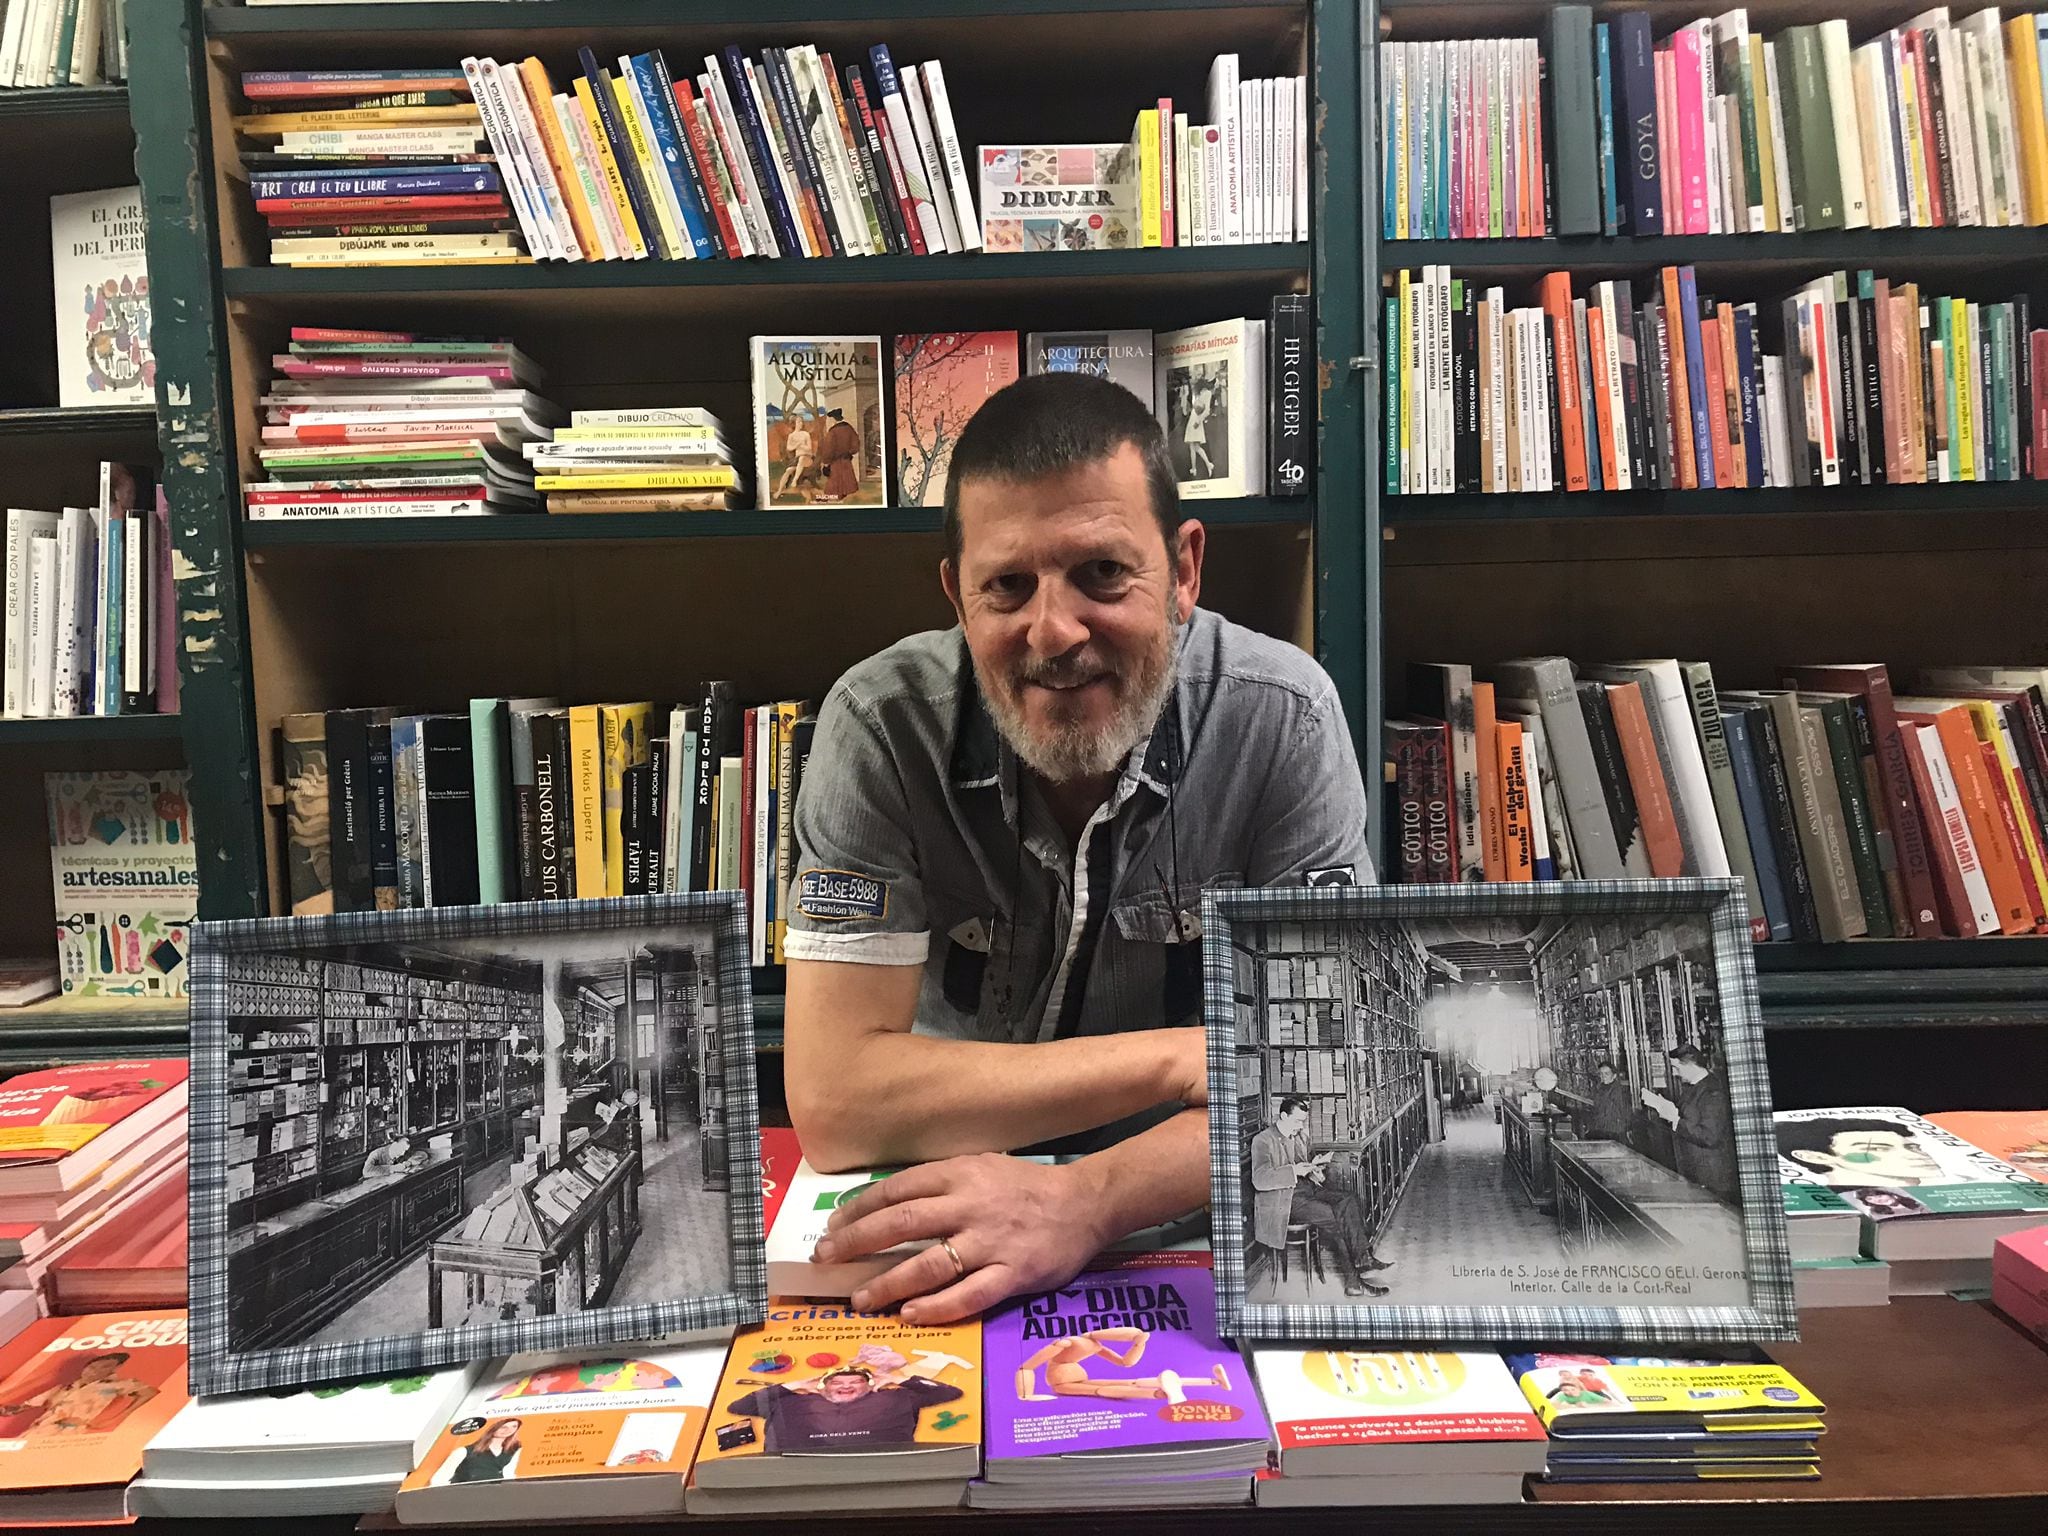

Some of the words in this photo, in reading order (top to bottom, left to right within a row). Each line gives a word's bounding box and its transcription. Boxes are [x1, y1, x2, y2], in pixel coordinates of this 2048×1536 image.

[1705, 45, 1713, 98] CROMÁTICA
[591, 82, 607, 112] BOTÁNICA
[356, 132, 382, 140] MANGA
[385, 132, 414, 140] MASTER
[416, 130, 442, 139] CLASS
[602, 111, 618, 144] ACUARELA
[1936, 110, 1948, 160] LEONARDO
[309, 134, 342, 144] CHIBI
[866, 128, 881, 152] TINTA
[946, 135, 958, 158] VEGETAL
[1227, 116, 1236, 164] ARTÍSTICA
[1637, 113, 1654, 180] GOYA
[782, 151, 795, 173] LAB
[812, 128, 834, 181] ilustrador
[847, 146, 864, 183] COLOR
[951, 159, 961, 176] TINTA
[1207, 146, 1215, 187] botánica
[829, 184, 841, 201] Ser
[858, 183, 868, 197] EL
[1000, 190, 1115, 208] DIBUJAR
[1192, 186, 1200, 199] del
[1228, 166, 1238, 215] ANATOMÍA
[92, 209, 112, 223] EL
[117, 205, 144, 220] GR
[1192, 202, 1201, 229] Dibujo
[1208, 188, 1217, 230] Ilustración
[340, 238, 387, 250] DIBÚJAME
[392, 241, 410, 249] una
[414, 240, 434, 248] casa
[1388, 304, 1396, 353] FONTCUBERTA
[1208, 335, 1238, 349] MÍTICAS
[1284, 338, 1300, 366] HR
[768, 352, 858, 368] ALQUIMIA
[1038, 346, 1145, 361] ARQUITECTURA
[1958, 345, 1967, 382] fotografía
[361, 366, 400, 374] CREATIVO
[402, 366, 440, 374] GOUACHE
[784, 367, 856, 381] MÍSTICA
[1038, 363, 1110, 376] MODERNA
[1444, 380, 1450, 390] LA
[1742, 376, 1752, 404] egipcio
[1844, 370, 1853, 410] FOTOGRAFÍA
[1284, 370, 1300, 438] GIGER
[1961, 392, 1966, 400] de
[618, 414, 649, 422] DIBUJO
[652, 412, 694, 422] CREATIVO
[1390, 417, 1396, 426] DE
[1390, 456, 1396, 466] LA
[648, 476, 689, 484] DIBUJAR
[692, 476, 699, 484] Y
[702, 476, 722, 484] VER
[1571, 476, 1584, 484] GG
[282, 504, 339, 516] ANATOMÍA
[343, 504, 402, 515] ARTÍSTICA
[10, 518, 20, 551] PALÉS
[10, 554, 18, 574] CON
[9, 576, 18, 617] CREAR
[702, 698, 713, 734] FADE
[1694, 678, 1724, 742] ZULOAGA
[606, 718, 616, 733] ALEX
[607, 734, 616, 750] KATZ
[702, 739, 710, 756] TO
[1806, 726, 1823, 776] PICASSO
[416, 736, 424, 790] VILADECANS
[582, 748, 592, 792] Markus
[652, 752, 660, 771] PALAU
[1511, 746, 1525, 787] grafiti
[700, 760, 710, 805] BLACK
[1506, 766, 1518, 816] alfabeto
[538, 754, 556, 860] CARBONELL
[1516, 791, 1524, 810] del
[583, 795, 593, 842] Lüpertz
[1509, 820, 1518, 837] El
[1944, 808, 1964, 840] VERMELLA
[780, 822, 790, 838] EN
[1403, 801, 1420, 863] GÓTICO
[1428, 800, 1448, 863] GÓTICO
[1520, 826, 1529, 868] Woshe
[1824, 814, 1844, 877] QUADERNS
[1955, 842, 1973, 863] CAPSA
[62, 856, 119, 867] técnicas
[122, 858, 130, 867] y
[134, 856, 195, 867] proyecto
[628, 840, 640, 884] TÀPIES
[779, 846, 789, 882] ARTE
[1962, 862, 1976, 874] LA
[63, 866, 200, 886] artesanales
[1837, 878, 1849, 900] ELS
[1500, 1265, 1514, 1278] de
[1518, 1266, 1530, 1278] S.
[1564, 1266, 1578, 1278] de
[1582, 1265, 1661, 1279] FRANCISCO
[1704, 1267, 1748, 1280] Gerona
[1562, 1281, 1592, 1294] Calle
[1598, 1282, 1612, 1293] de
[1618, 1282, 1628, 1293] la
[1634, 1282, 1692, 1295] Cort-Real
[786, 1332, 832, 1342] saber
[835, 1334, 862, 1342] per
[866, 1332, 888, 1340] fer
[916, 1330, 952, 1340] pare
[864, 1324, 895, 1333] que
[1172, 1404, 1230, 1414] YONKI
[543, 1430, 604, 1438] exemplars
[1296, 1432, 1338, 1440] hecho»
[1353, 1428, 1392, 1438] «¿Qué
[1445, 1426, 1490, 1435] pasado
